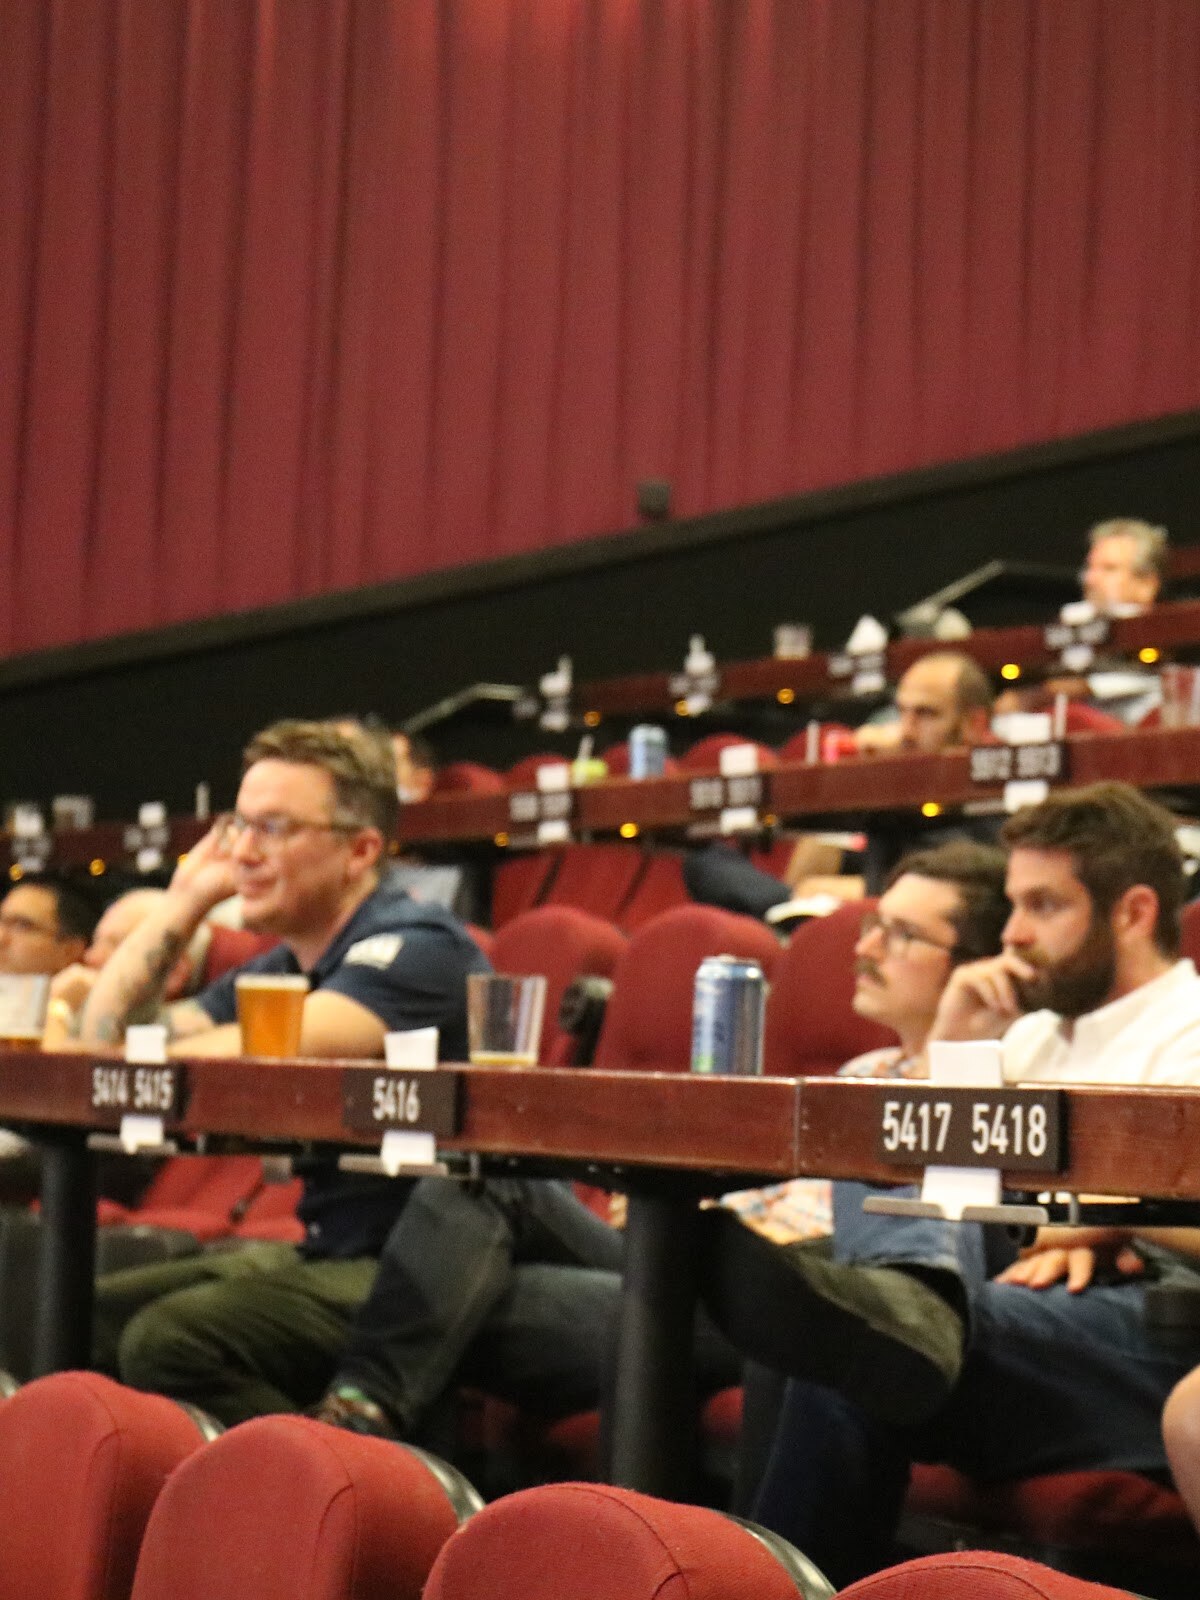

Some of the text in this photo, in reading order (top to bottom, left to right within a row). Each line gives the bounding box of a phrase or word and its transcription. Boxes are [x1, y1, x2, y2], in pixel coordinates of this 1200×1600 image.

[92, 1067, 174, 1110] 5414 5415
[372, 1077, 419, 1122] 5416
[882, 1102, 1047, 1157] 5417 5418
